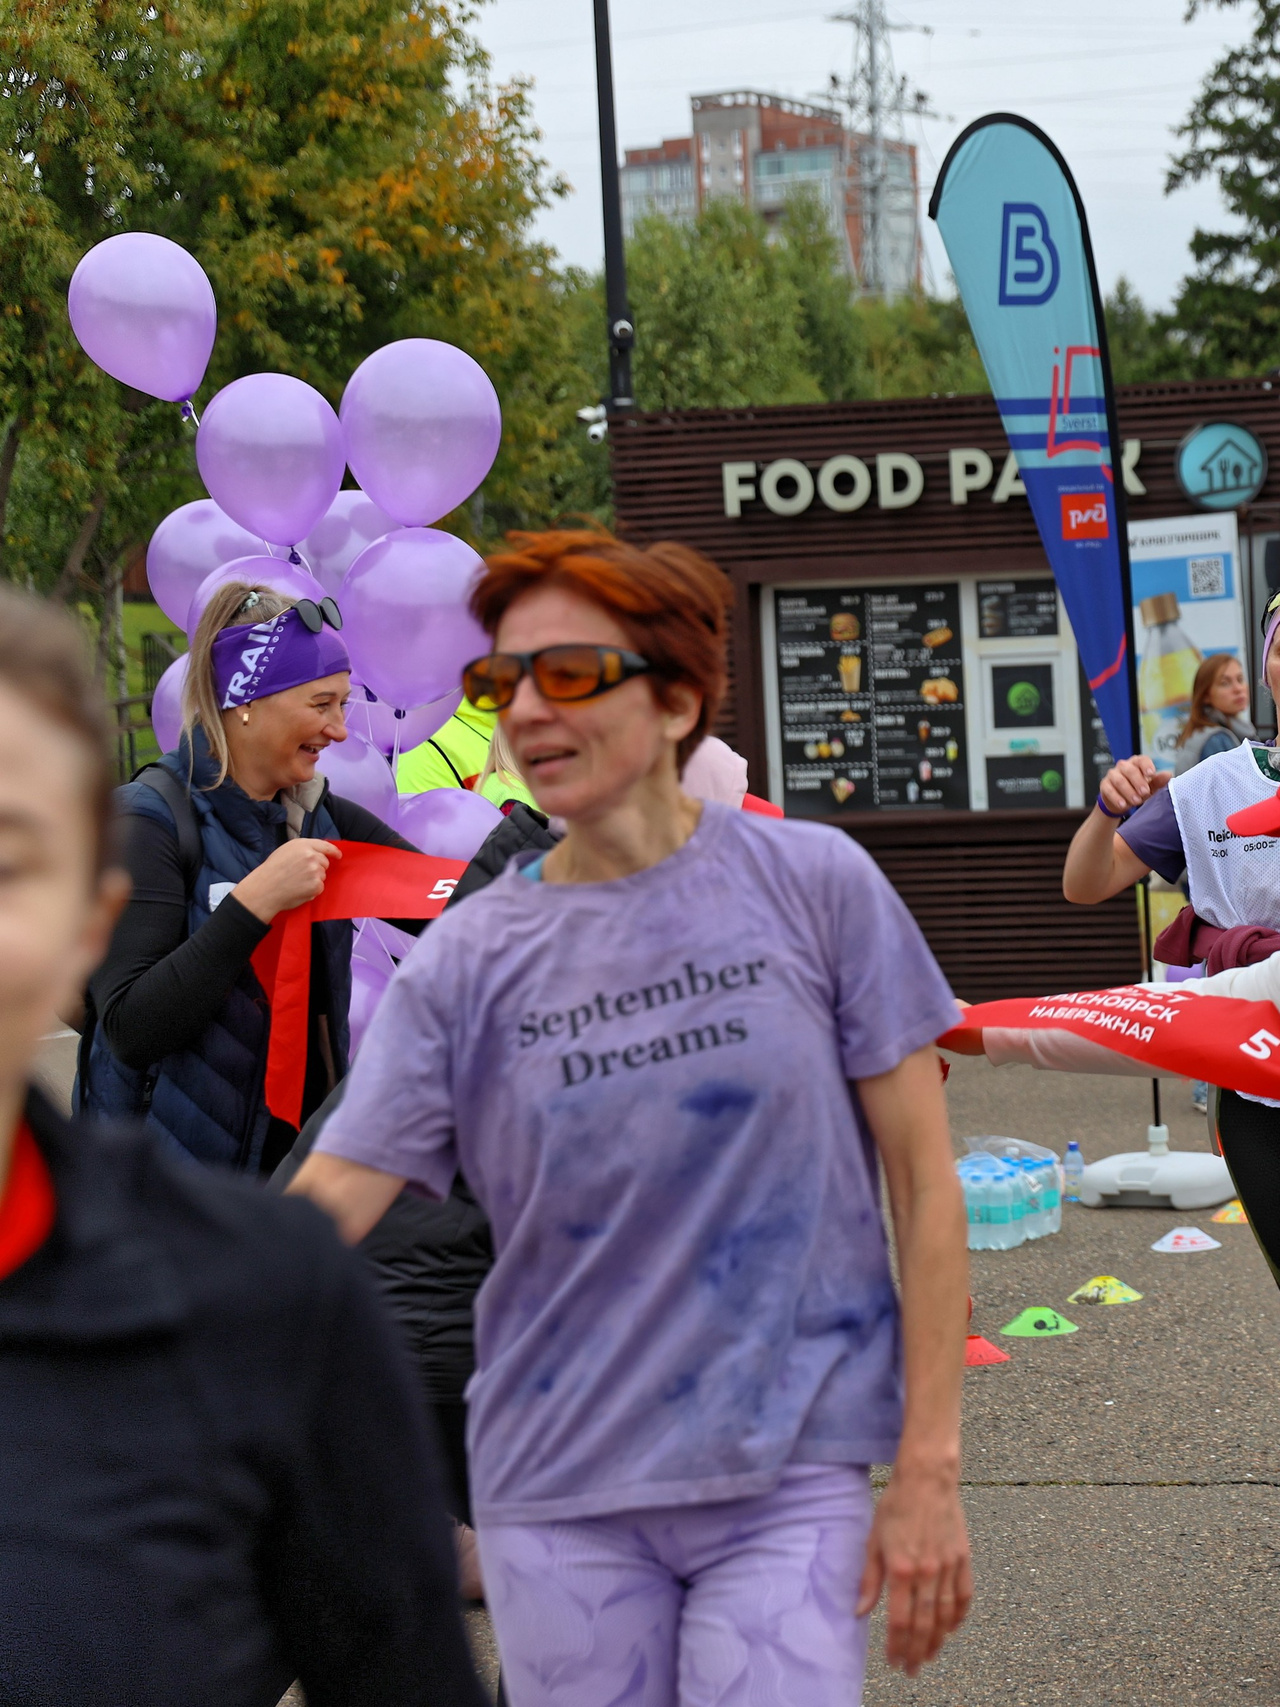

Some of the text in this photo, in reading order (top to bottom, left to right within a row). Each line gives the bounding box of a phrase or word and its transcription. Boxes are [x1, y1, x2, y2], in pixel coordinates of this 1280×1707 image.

[722, 438, 1147, 518] FOOD PAK
[1243, 840, 1268, 852] 05:00
[427, 878, 459, 899] 5
[517, 958, 768, 1049] September
[1028, 1005, 1156, 1043] НАБЕРЕЖНАЯ
[561, 1016, 749, 1089] Dreams
